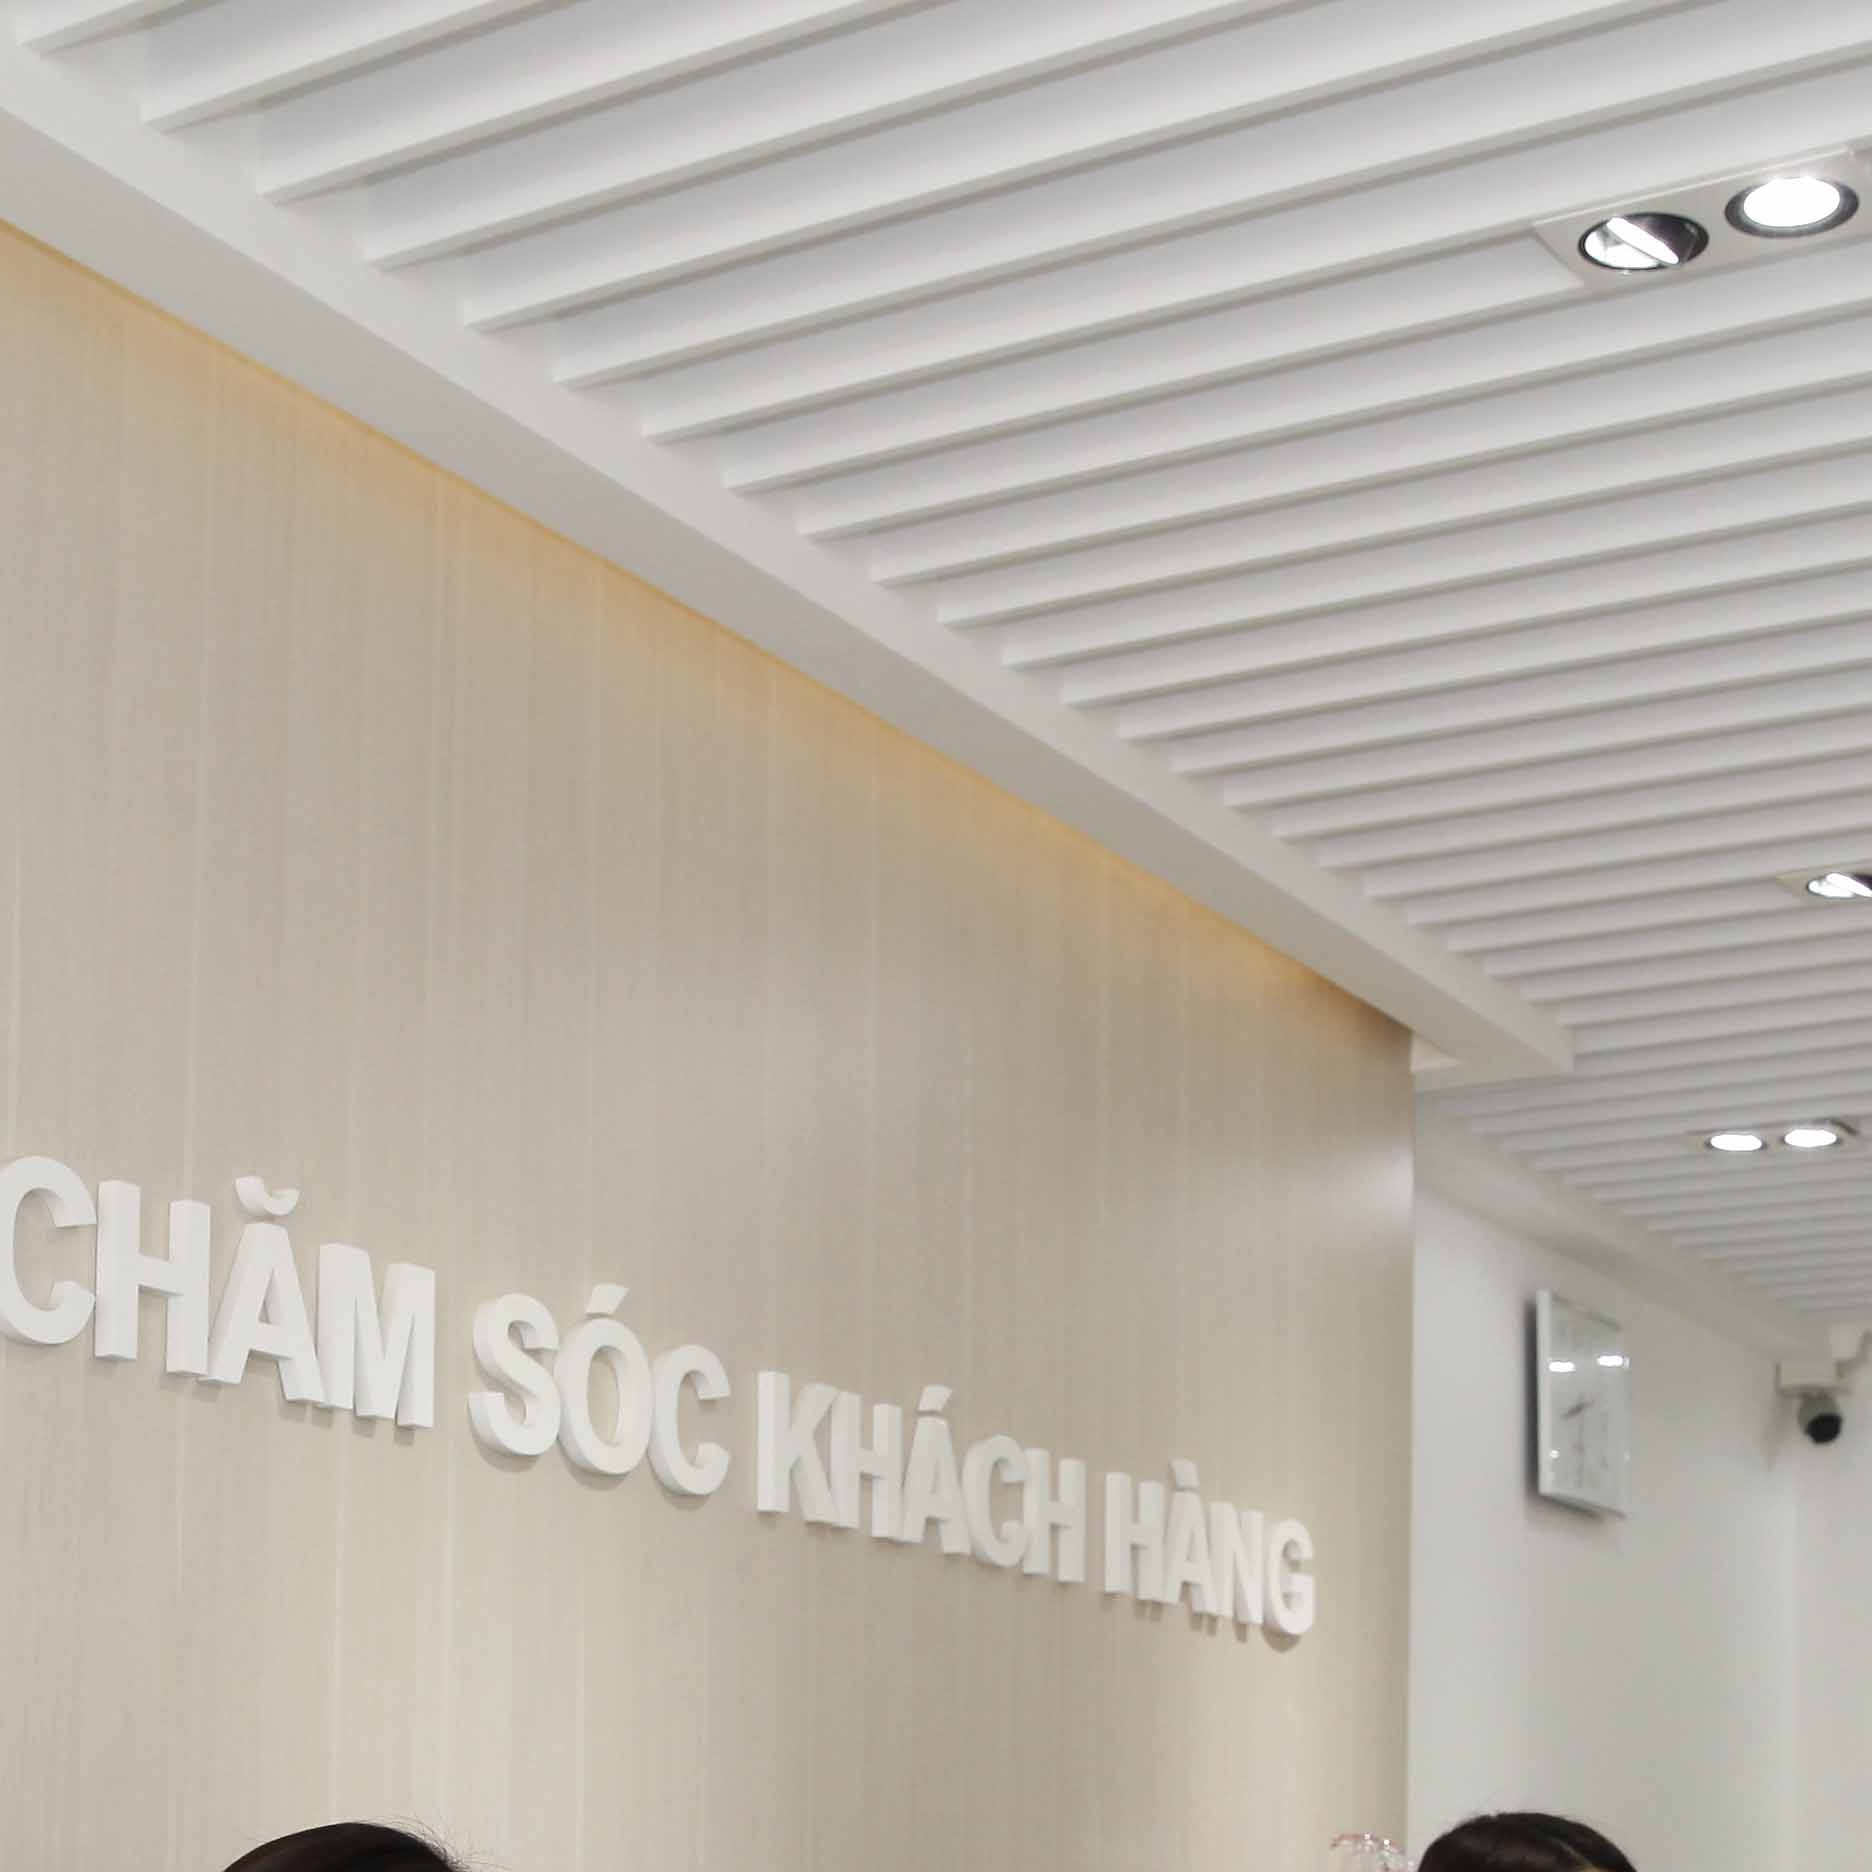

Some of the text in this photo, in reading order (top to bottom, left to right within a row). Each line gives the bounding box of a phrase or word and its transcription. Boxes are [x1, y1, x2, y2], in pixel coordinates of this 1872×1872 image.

[468, 1282, 730, 1496] SÓC
[756, 1385, 1085, 1584] KHÁCH
[1104, 1459, 1316, 1636] HÀNG
